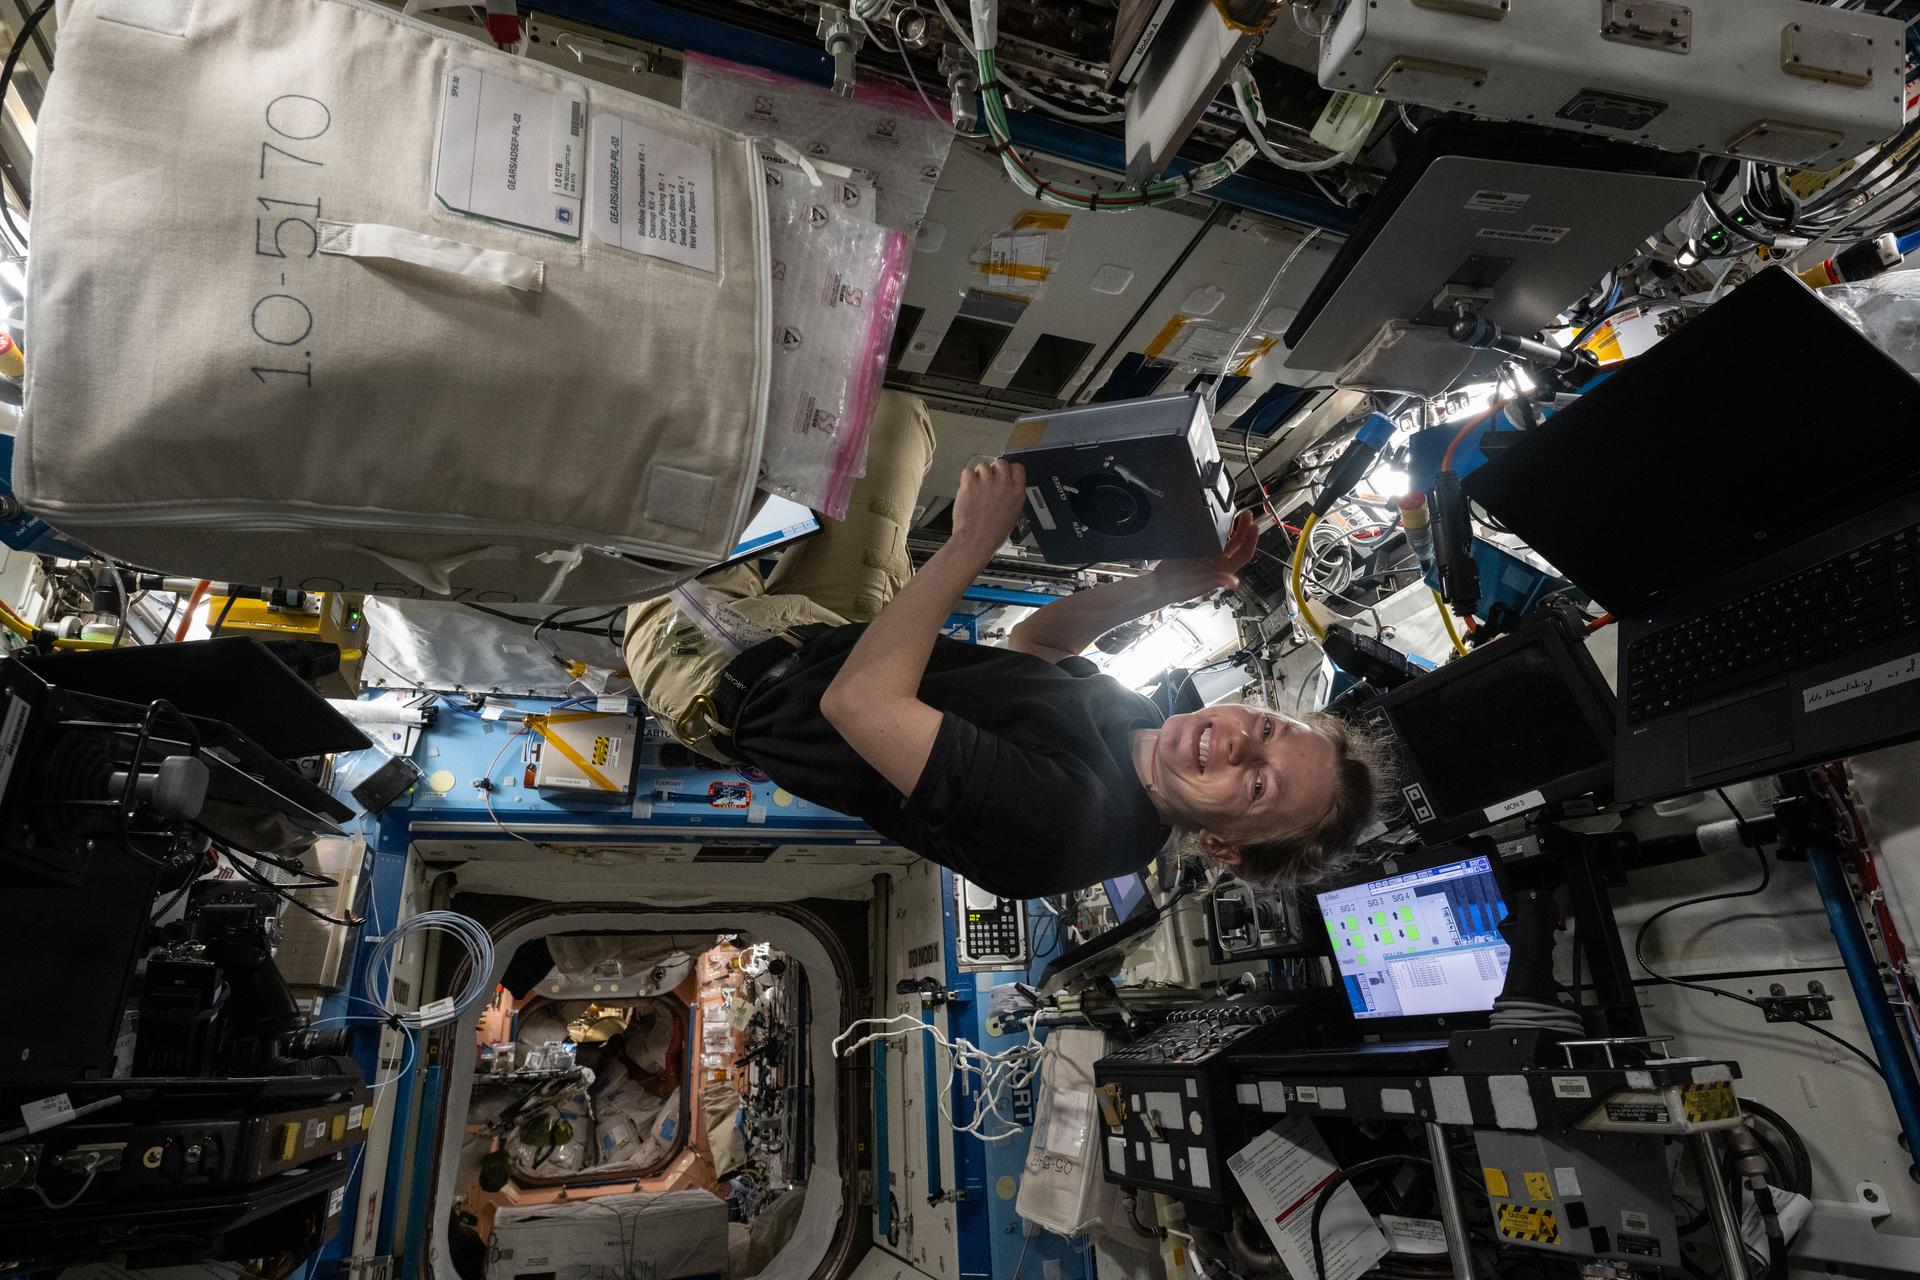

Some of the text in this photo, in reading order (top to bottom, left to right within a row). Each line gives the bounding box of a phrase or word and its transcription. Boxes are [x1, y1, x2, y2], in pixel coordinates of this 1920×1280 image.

[1135, 34, 1154, 56] Module
[451, 76, 460, 97] SPX-30
[508, 112, 522, 191] GEARS/ADSEP-PIL-02
[555, 163, 563, 188] 1.0 CTB
[609, 136, 620, 224] GEARS/ADSEP-PIL-02
[659, 193, 667, 216] Picking
[668, 194, 676, 212] Block
[659, 217, 667, 240] Colony
[689, 215, 697, 235] Wipes
[669, 231, 677, 244] PCR
[1052, 475, 1067, 501] CLOSED
[724, 671, 747, 691] ARCADE
[1504, 801, 1519, 813] MON
[908, 948, 919, 968] TO
[1008, 1048, 1033, 1123] PORT
